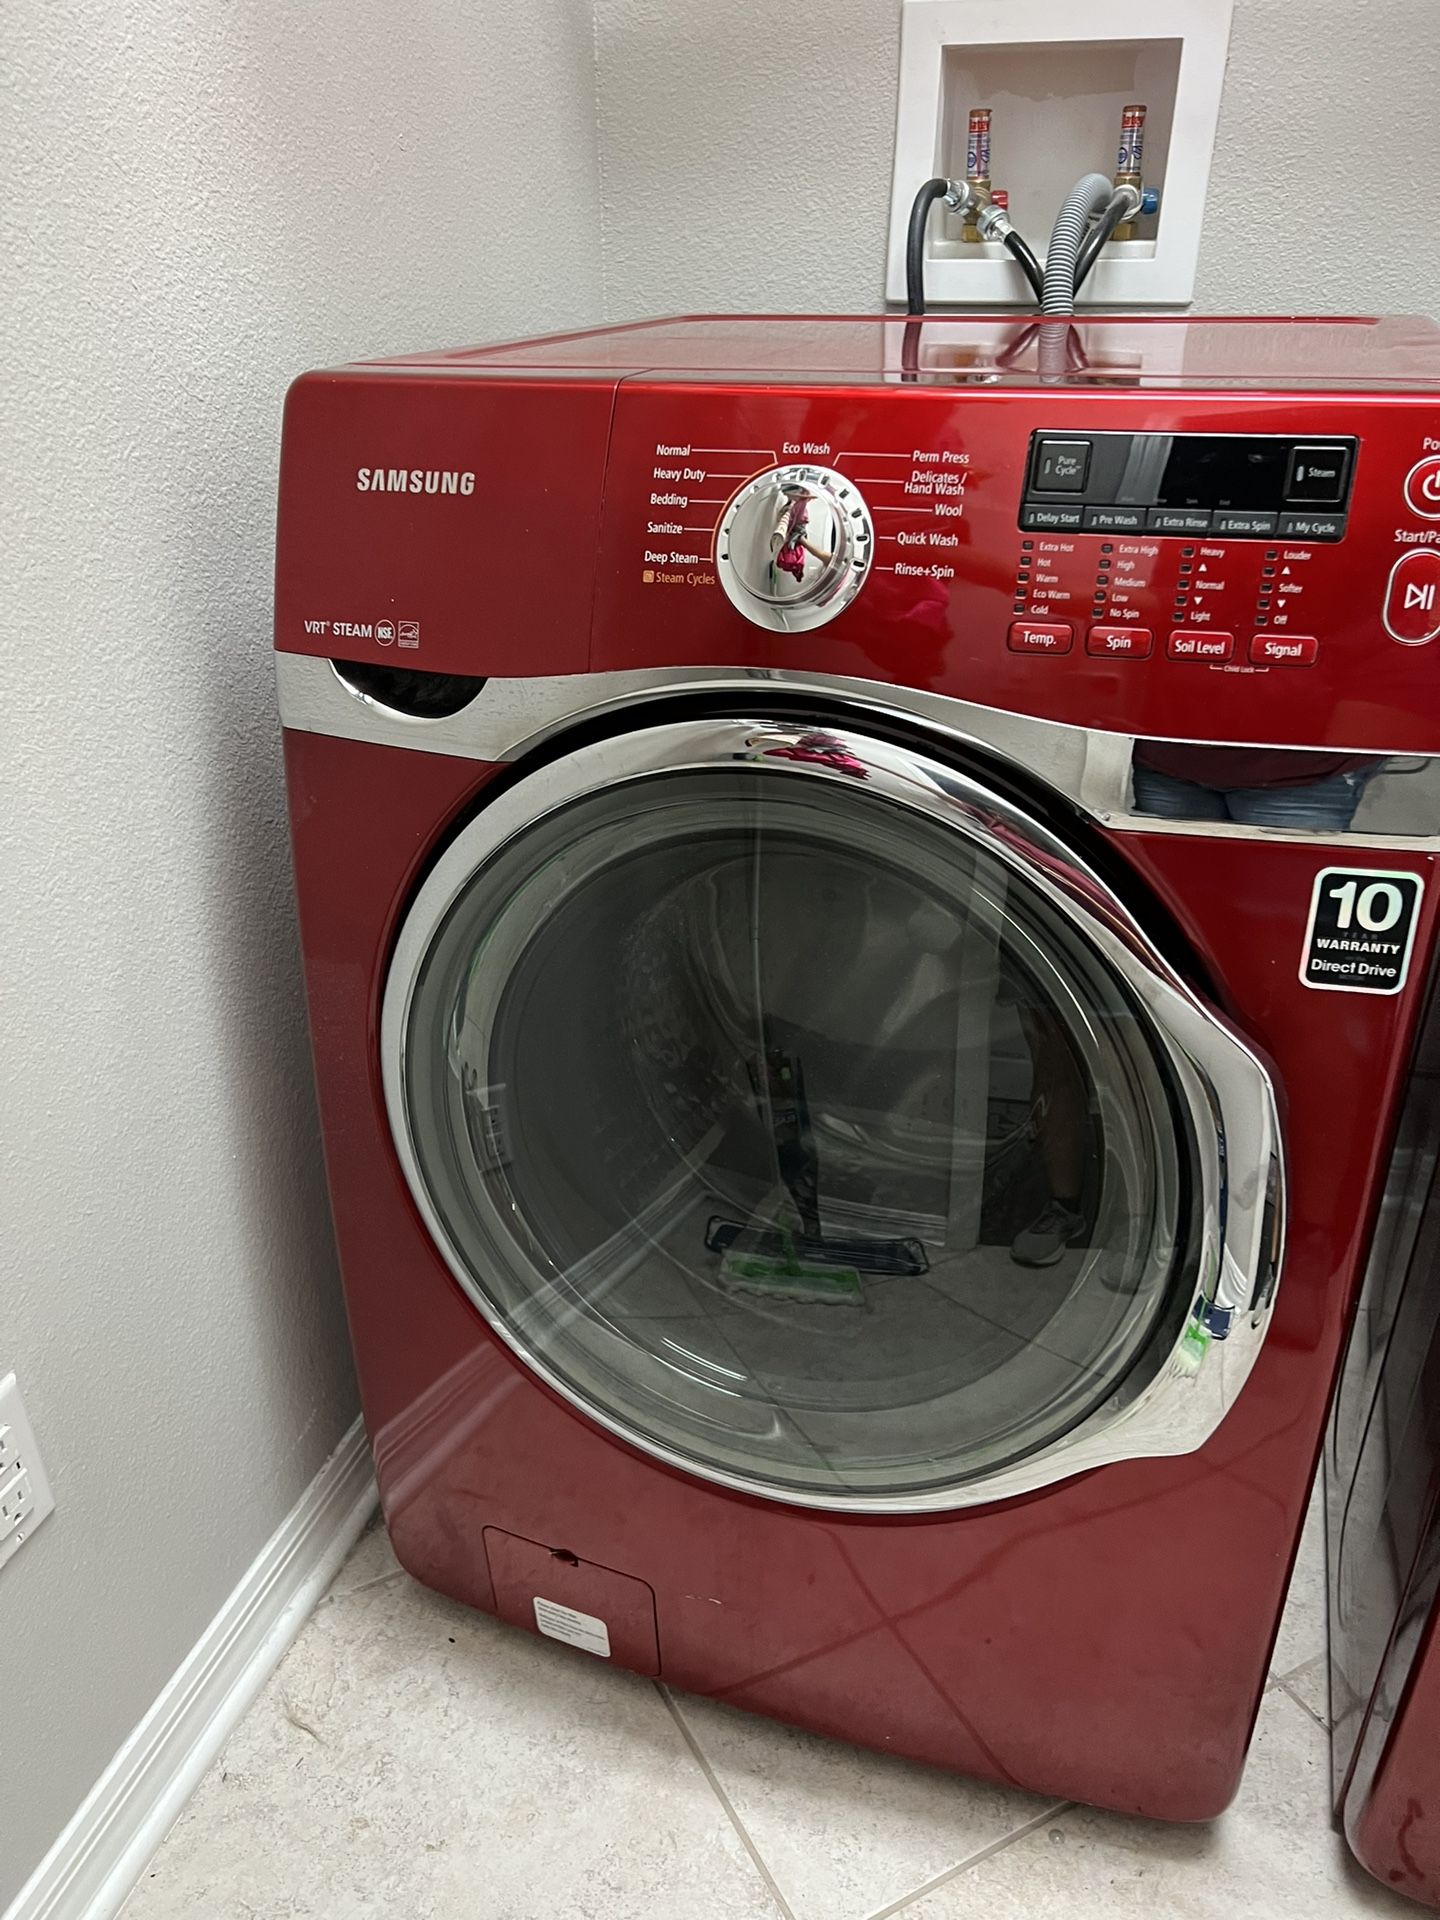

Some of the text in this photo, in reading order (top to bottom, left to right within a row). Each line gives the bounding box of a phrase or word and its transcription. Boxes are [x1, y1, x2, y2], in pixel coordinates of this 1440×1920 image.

[656, 445, 691, 457] Normal
[783, 442, 830, 455] Eco Wash
[913, 451, 969, 464] Perm Press
[1058, 456, 1076, 465] Pure
[654, 468, 706, 483] Heavy Duty
[912, 471, 958, 483] Delicates
[1308, 468, 1335, 477] Steam
[357, 468, 475, 495] SAMSUNG
[904, 482, 965, 495] Hand Wash
[650, 494, 688, 507] Bedding
[935, 504, 963, 516] Wool
[1037, 514, 1080, 525] Delay Start
[1099, 514, 1137, 525] Pre Wash
[1163, 517, 1208, 528] Extra Rinse
[647, 522, 683, 534] Sanitize
[1228, 520, 1271, 532] Extra Spin
[1296, 522, 1335, 534] My Cycle
[897, 532, 959, 546] Quick Wash
[1040, 542, 1074, 552] Extra Hot
[1120, 544, 1159, 557] Extra High
[1200, 548, 1225, 558] Heavy
[644, 552, 698, 565] Deep Steam
[1284, 551, 1311, 560] Louder
[1038, 558, 1051, 567] Hot
[1117, 560, 1135, 572] High
[895, 563, 955, 579] Rinse+Spin
[656, 572, 715, 585] Steam Cycles
[1036, 574, 1058, 583] Warm
[1114, 578, 1145, 587] Medium
[1196, 580, 1224, 590] Normal
[1279, 584, 1303, 594] Softer
[1033, 590, 1070, 599] Eco Warm
[1112, 594, 1128, 602] Low
[1031, 605, 1049, 615] Cold
[1110, 608, 1139, 620] No Spin
[1191, 612, 1211, 622] Light
[1274, 615, 1288, 625] Off
[333, 622, 372, 638] STEAM
[1024, 631, 1057, 647] Temp.
[1106, 635, 1131, 651] Spin
[1175, 640, 1225, 655] Soil Level
[1264, 642, 1302, 659] Signal
[1329, 881, 1403, 931] 10
[1317, 938, 1401, 955] WARRANTY
[1311, 958, 1356, 973] Direct
[1358, 962, 1397, 977] Drive
